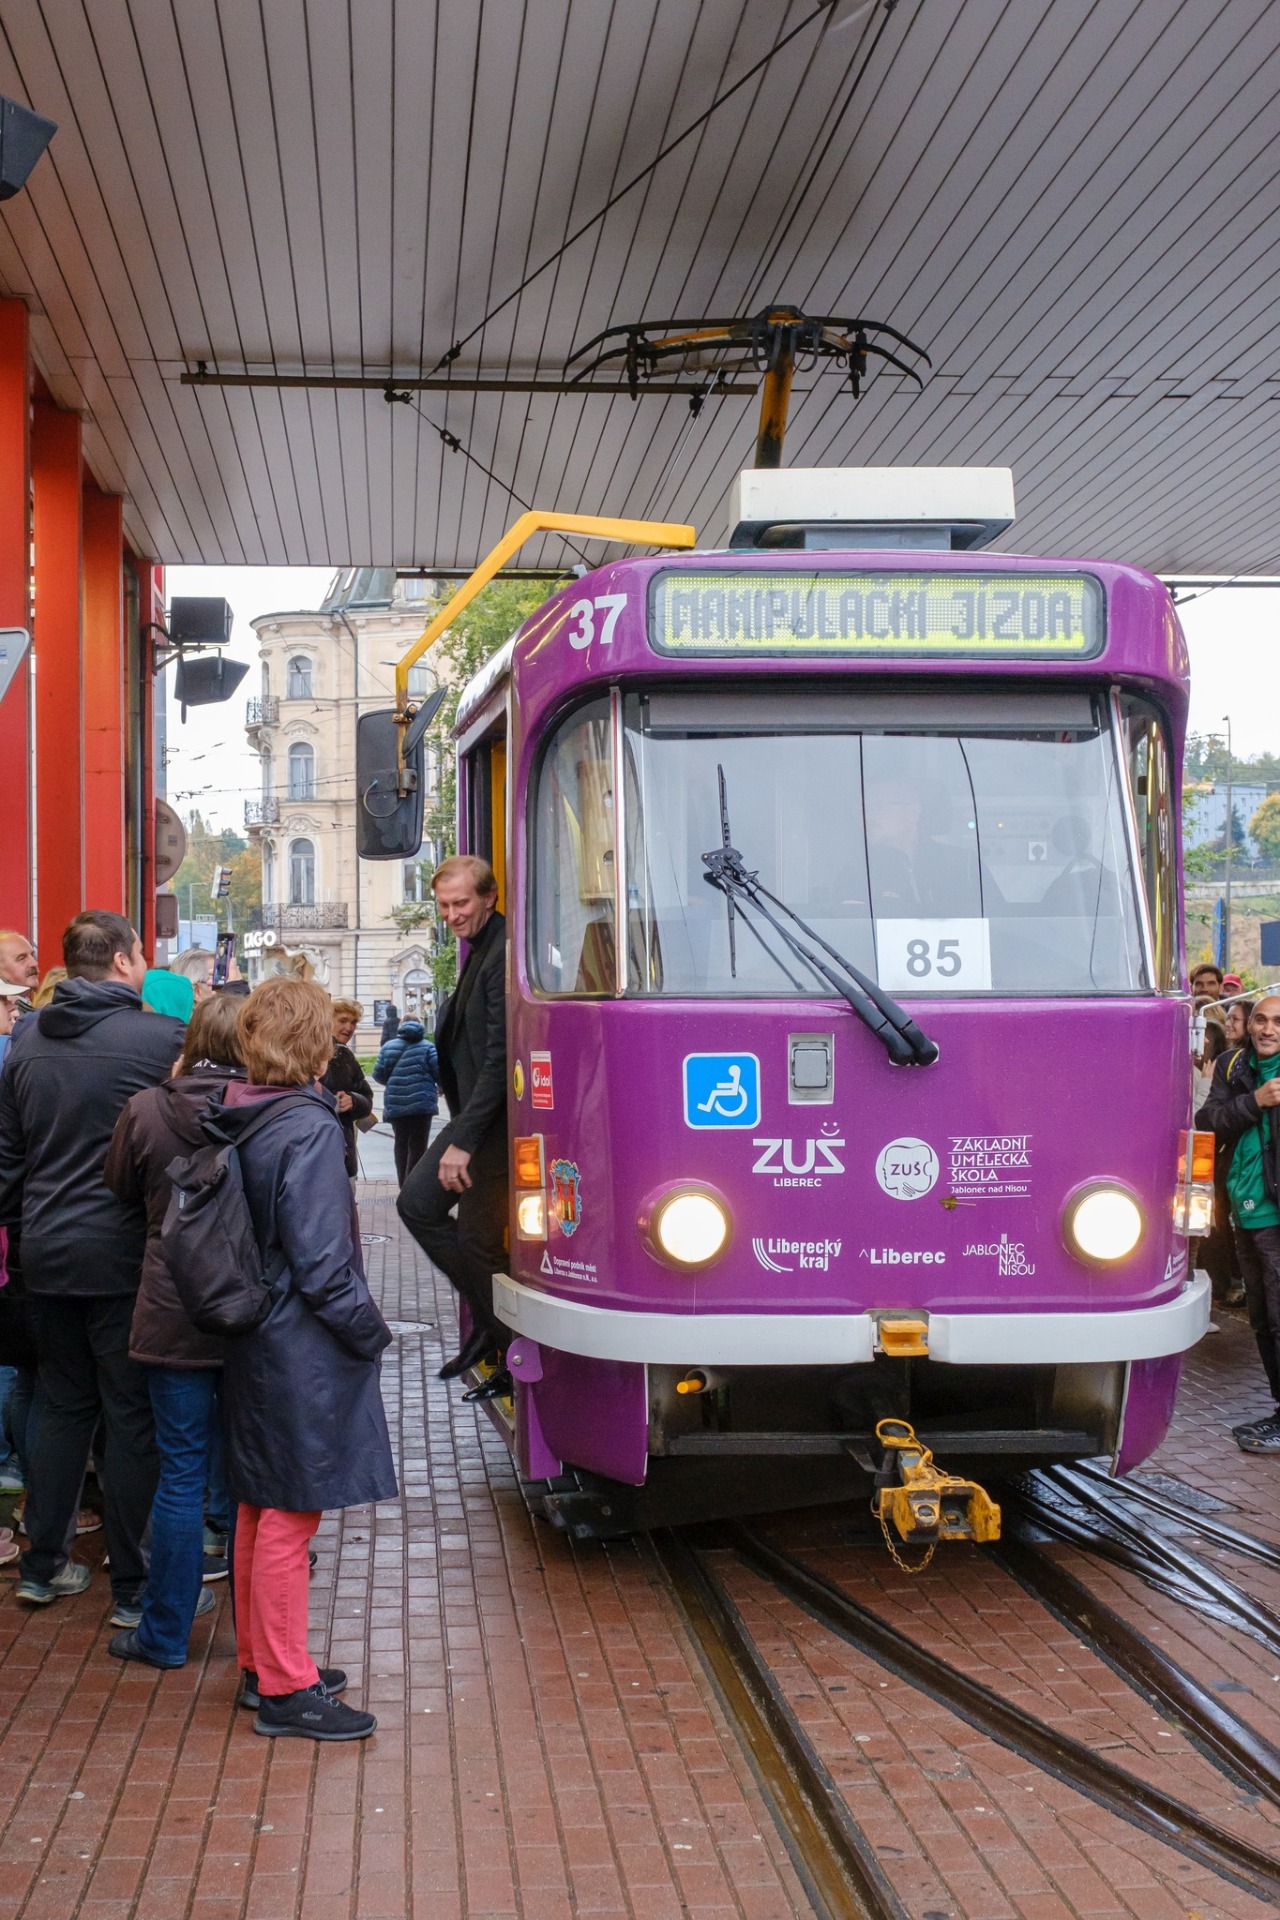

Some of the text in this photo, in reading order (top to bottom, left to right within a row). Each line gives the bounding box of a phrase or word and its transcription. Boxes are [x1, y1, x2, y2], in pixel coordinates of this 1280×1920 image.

[952, 580, 1071, 640] JÍZDA
[569, 593, 628, 650] 37
[906, 938, 962, 977] 85
[952, 1135, 1027, 1152] ZÁKLADNÍ
[951, 1151, 1030, 1167] UMĚLECKÁ
[890, 1161, 922, 1176] ZUŠ
[951, 1167, 999, 1182] ŠKOLA
[773, 1177, 822, 1187] LIBEREC
[951, 1184, 1028, 1194] Jablonec nad Nisou
[1243, 1199, 1255, 1210] GR
[768, 1238, 842, 1257] Liberecký
[962, 1242, 1025, 1256] JABLONEC
[800, 1254, 829, 1271] kraj
[870, 1248, 946, 1264] Liberec
[999, 1253, 1026, 1265] NAD
[998, 1264, 1036, 1276] NISOU
